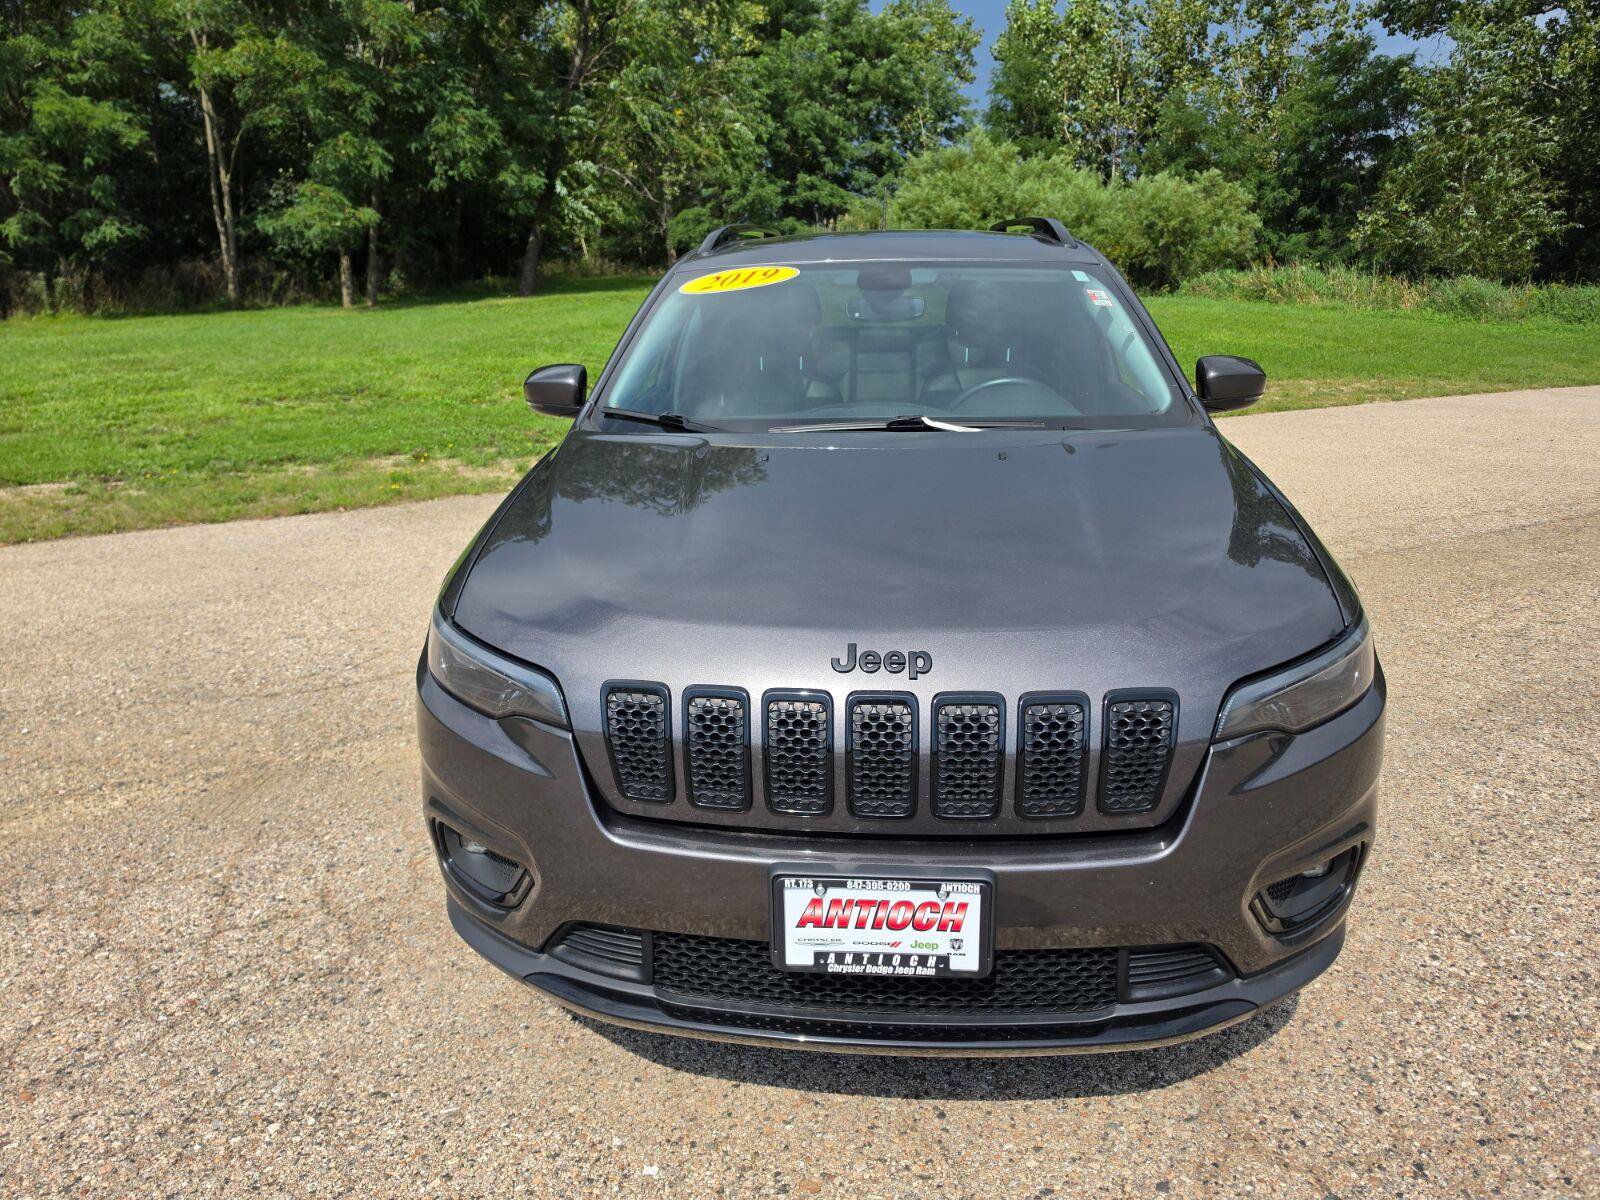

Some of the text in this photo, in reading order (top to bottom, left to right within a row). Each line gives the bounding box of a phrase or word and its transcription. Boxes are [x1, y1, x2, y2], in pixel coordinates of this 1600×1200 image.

[698, 268, 780, 291] 2019
[831, 643, 933, 680] Jeep
[799, 880, 814, 889] 173
[847, 880, 911, 891] 847-395-0200
[940, 883, 980, 893] ANTIOCH
[795, 897, 969, 932] ANTIOCH
[910, 940, 939, 951] Jeep
[828, 964, 936, 976] Chrysler Dodge Jeep Ram
